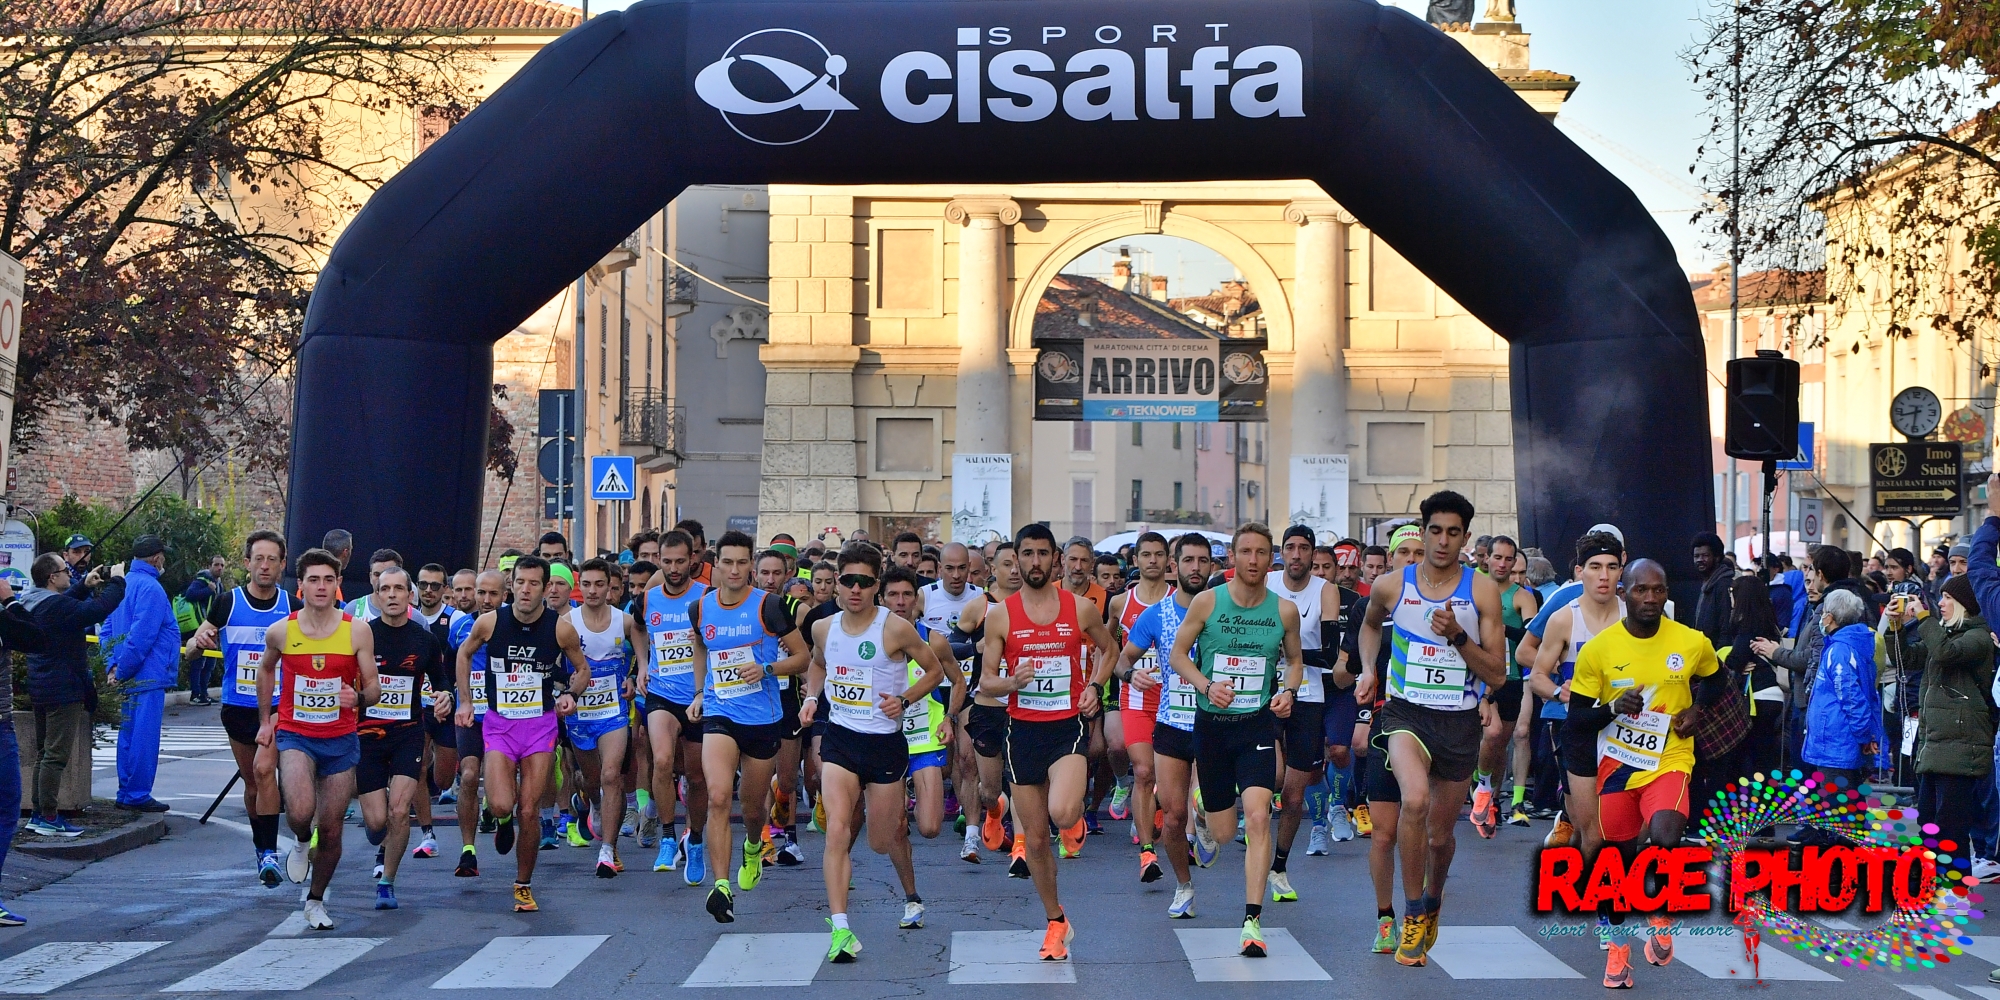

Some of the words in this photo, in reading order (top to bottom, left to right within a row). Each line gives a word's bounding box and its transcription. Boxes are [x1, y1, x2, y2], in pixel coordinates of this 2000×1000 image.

[988, 24, 1229, 45] SPORT
[880, 28, 1306, 123] cisalfa
[1181, 344, 1209, 352] CREMA
[1088, 357, 1215, 396] ARRIVO
[1126, 405, 1197, 416] TEKNOWEB
[1928, 409, 1936, 417] 3
[1926, 447, 1952, 460] Imo
[1920, 463, 1957, 476] Sushi
[1217, 613, 1231, 623] La
[1231, 615, 1277, 628] Recastello
[507, 645, 537, 658] EA7
[661, 646, 693, 660] T293
[243, 667, 255, 681] T1
[668, 664, 693, 672] TEKNOW
[717, 667, 742, 682] T29
[1425, 668, 1445, 684] T5
[726, 683, 760, 694] TEKNOWEB
[1035, 679, 1054, 692] T4
[1230, 676, 1245, 690] T1
[381, 692, 405, 705] 281
[503, 690, 536, 704] T267
[833, 683, 865, 701] T367
[1419, 692, 1460, 701] TEKNOWEB
[299, 694, 336, 708] T323
[581, 692, 614, 707] T224
[1031, 698, 1069, 707] TEKNOWEB
[1180, 694, 1196, 707] T1
[305, 712, 338, 720] TEKNOWEB
[510, 708, 541, 716] TEKNOWEB
[589, 707, 619, 717] TEKNOWEB
[838, 706, 870, 715] TEKNOWEB
[1213, 713, 1239, 722] NIKE
[902, 719, 915, 730] 3
[1641, 720, 1659, 729] Crema
[908, 735, 928, 743] NOWEB
[1615, 724, 1658, 751] T348
[1617, 750, 1657, 767] TEKNOWEB
